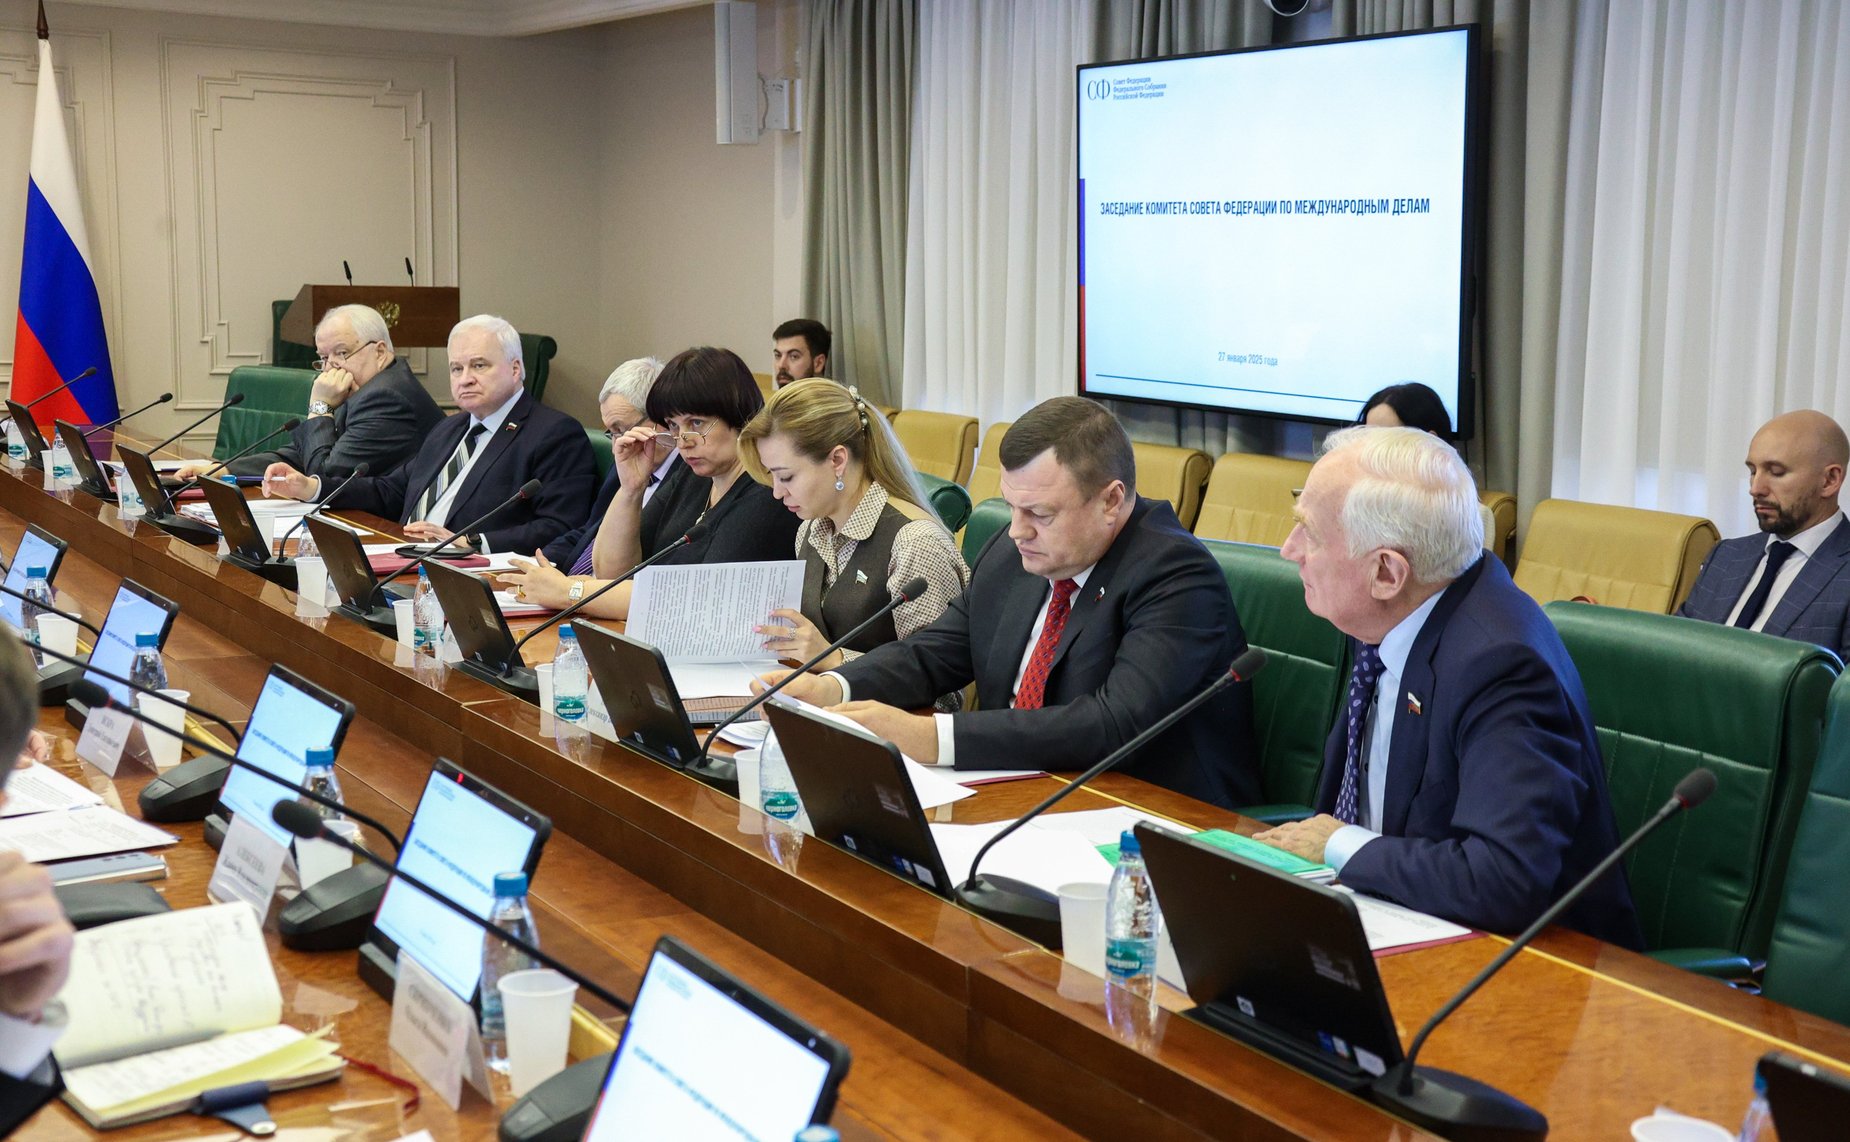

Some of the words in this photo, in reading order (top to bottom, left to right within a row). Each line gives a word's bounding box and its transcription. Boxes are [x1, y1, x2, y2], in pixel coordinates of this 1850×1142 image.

[1087, 79, 1111, 100] СФ
[1100, 201, 1144, 216] ЗАСЕДАНИЕ
[1146, 201, 1188, 215] КОМИТЕТА
[1189, 200, 1221, 215] СОВЕТА
[1223, 200, 1277, 216] ФЕДЕРАЦИИ
[1279, 200, 1292, 214] ПО
[1294, 199, 1389, 216] МЕЖДУНАРОДНЫМ
[1392, 198, 1430, 216] ДЕЛАМ
[1218, 351, 1226, 361] 27
[1227, 354, 1247, 364] января
[1248, 354, 1263, 364] 2025
[1264, 357, 1278, 367] года
